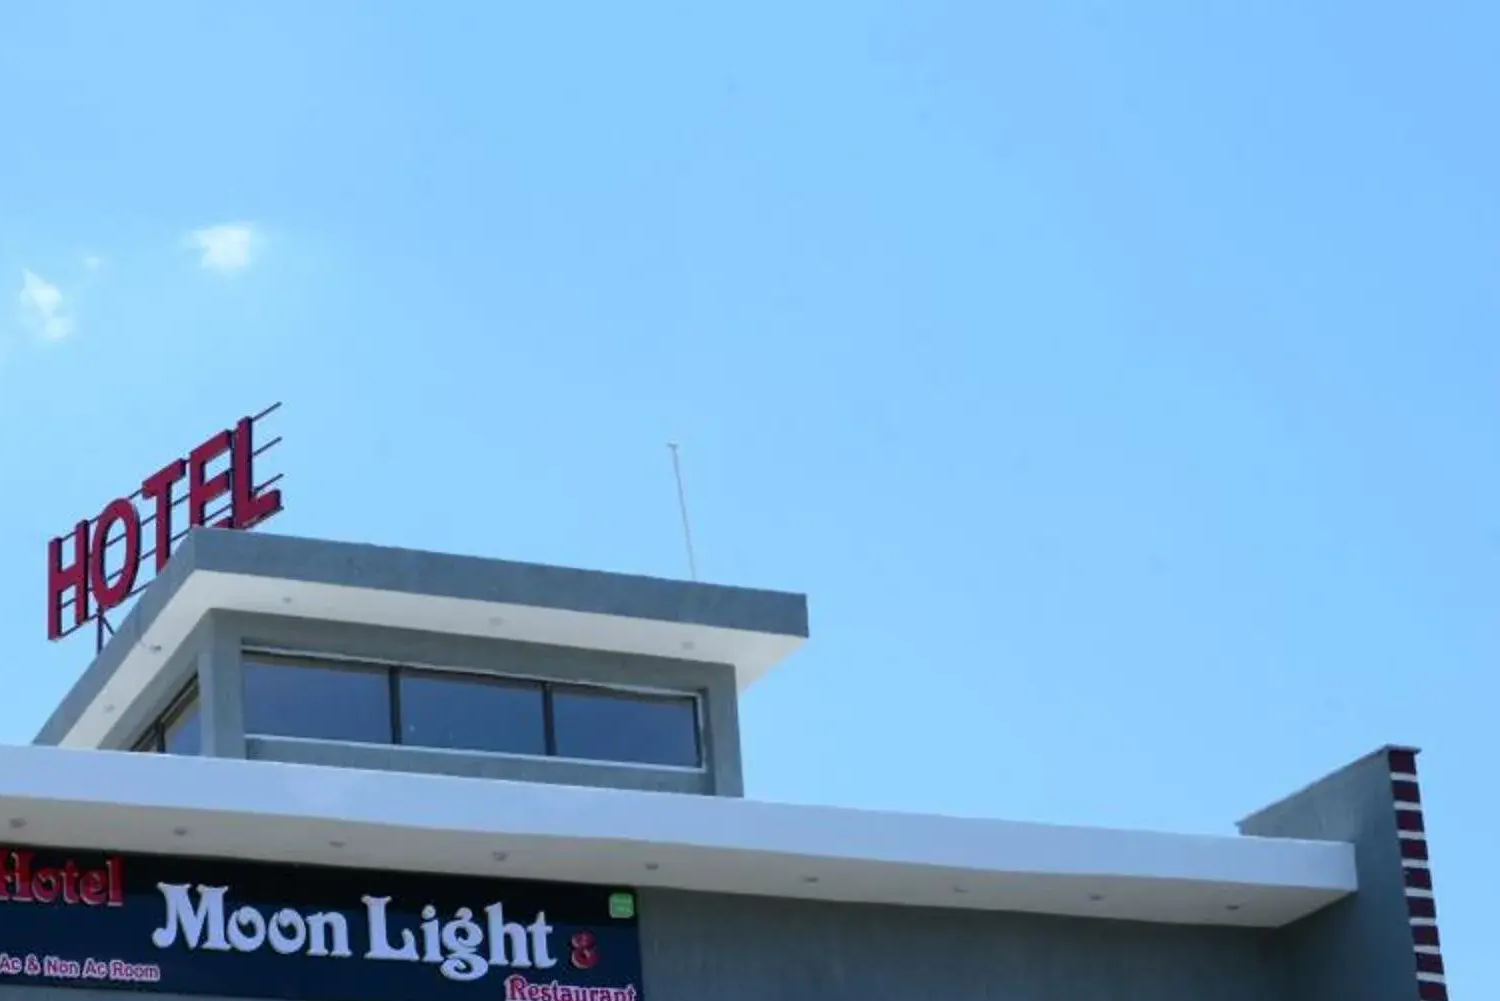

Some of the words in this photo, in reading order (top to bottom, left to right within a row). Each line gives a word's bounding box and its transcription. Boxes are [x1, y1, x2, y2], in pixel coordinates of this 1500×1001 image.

[48, 416, 281, 640] HOTEL
[24, 954, 41, 975] &
[43, 955, 80, 978] Non
[82, 958, 107, 979] Ac
[110, 960, 161, 981] Room
[152, 882, 352, 957] Moon
[362, 895, 557, 981] Light
